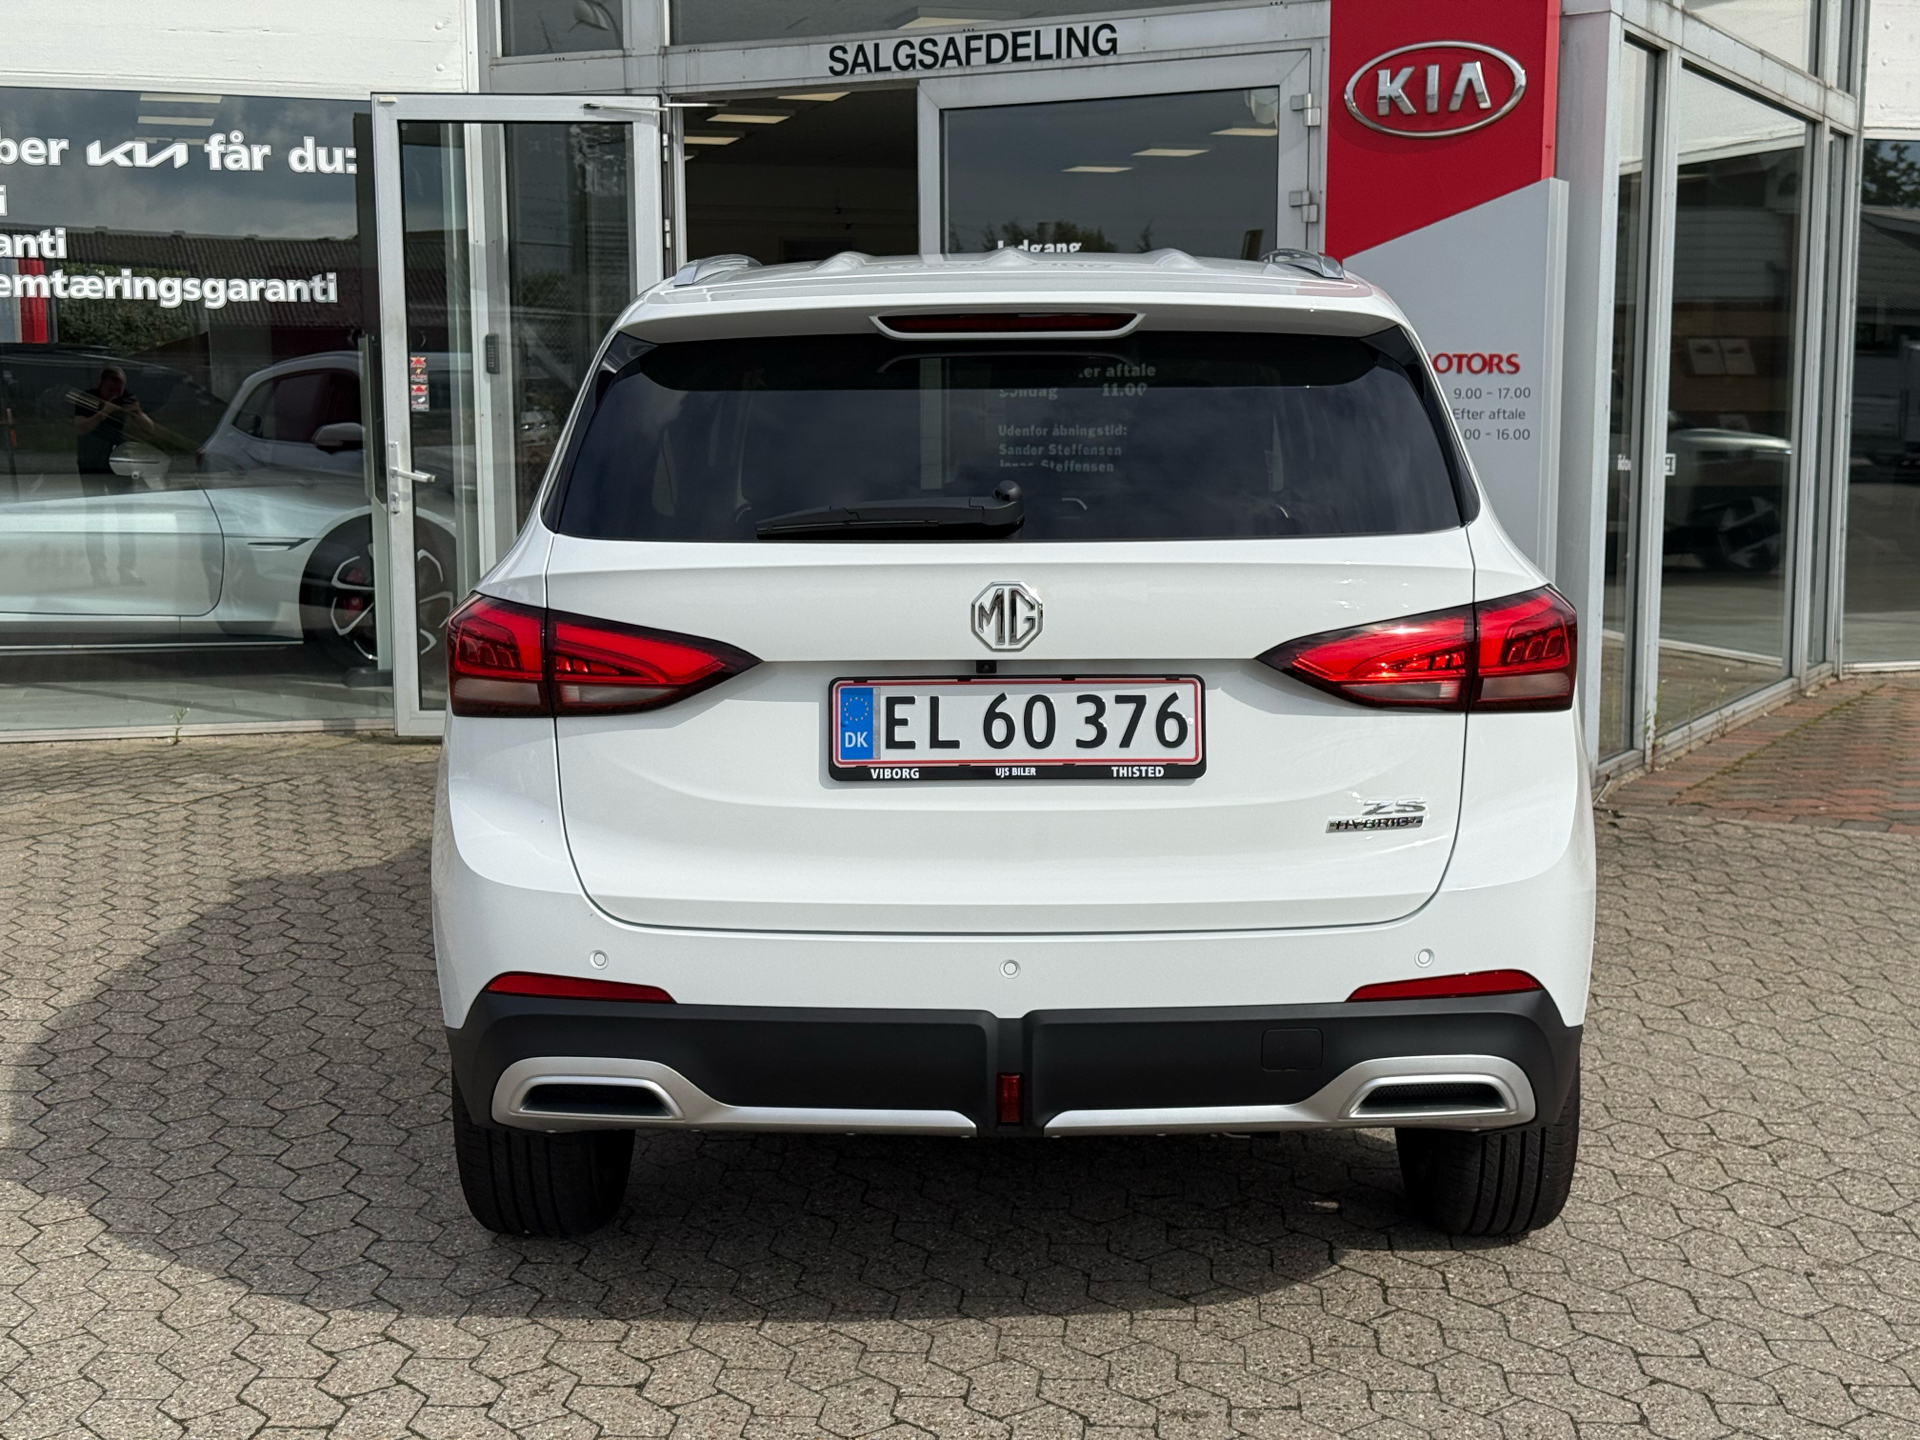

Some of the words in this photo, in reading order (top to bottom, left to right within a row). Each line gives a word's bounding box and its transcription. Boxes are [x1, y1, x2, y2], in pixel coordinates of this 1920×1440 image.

[828, 23, 1118, 76] SALGSAFDELING
[1376, 60, 1492, 116] KIA
[204, 130, 271, 173] får
[288, 136, 357, 174] du:
[1105, 363, 1156, 378] aftale
[1428, 352, 1521, 375] OTORS
[1498, 387, 1531, 399] 17.00
[1488, 408, 1526, 420] aftale
[998, 424, 1048, 437] Udenfor
[1496, 428, 1530, 440] 16.00
[998, 443, 1045, 456] Sander
[1048, 443, 1122, 456] Steffensen
[976, 586, 1037, 646] MG
[885, 695, 960, 749] EL
[983, 692, 1056, 749] 60
[1076, 691, 1189, 749] 376
[844, 731, 868, 748] DK
[870, 767, 920, 779] VIBORG
[1011, 767, 1037, 776] BILER
[1111, 766, 1164, 778] THISTED
[1361, 798, 1427, 816] ZS
